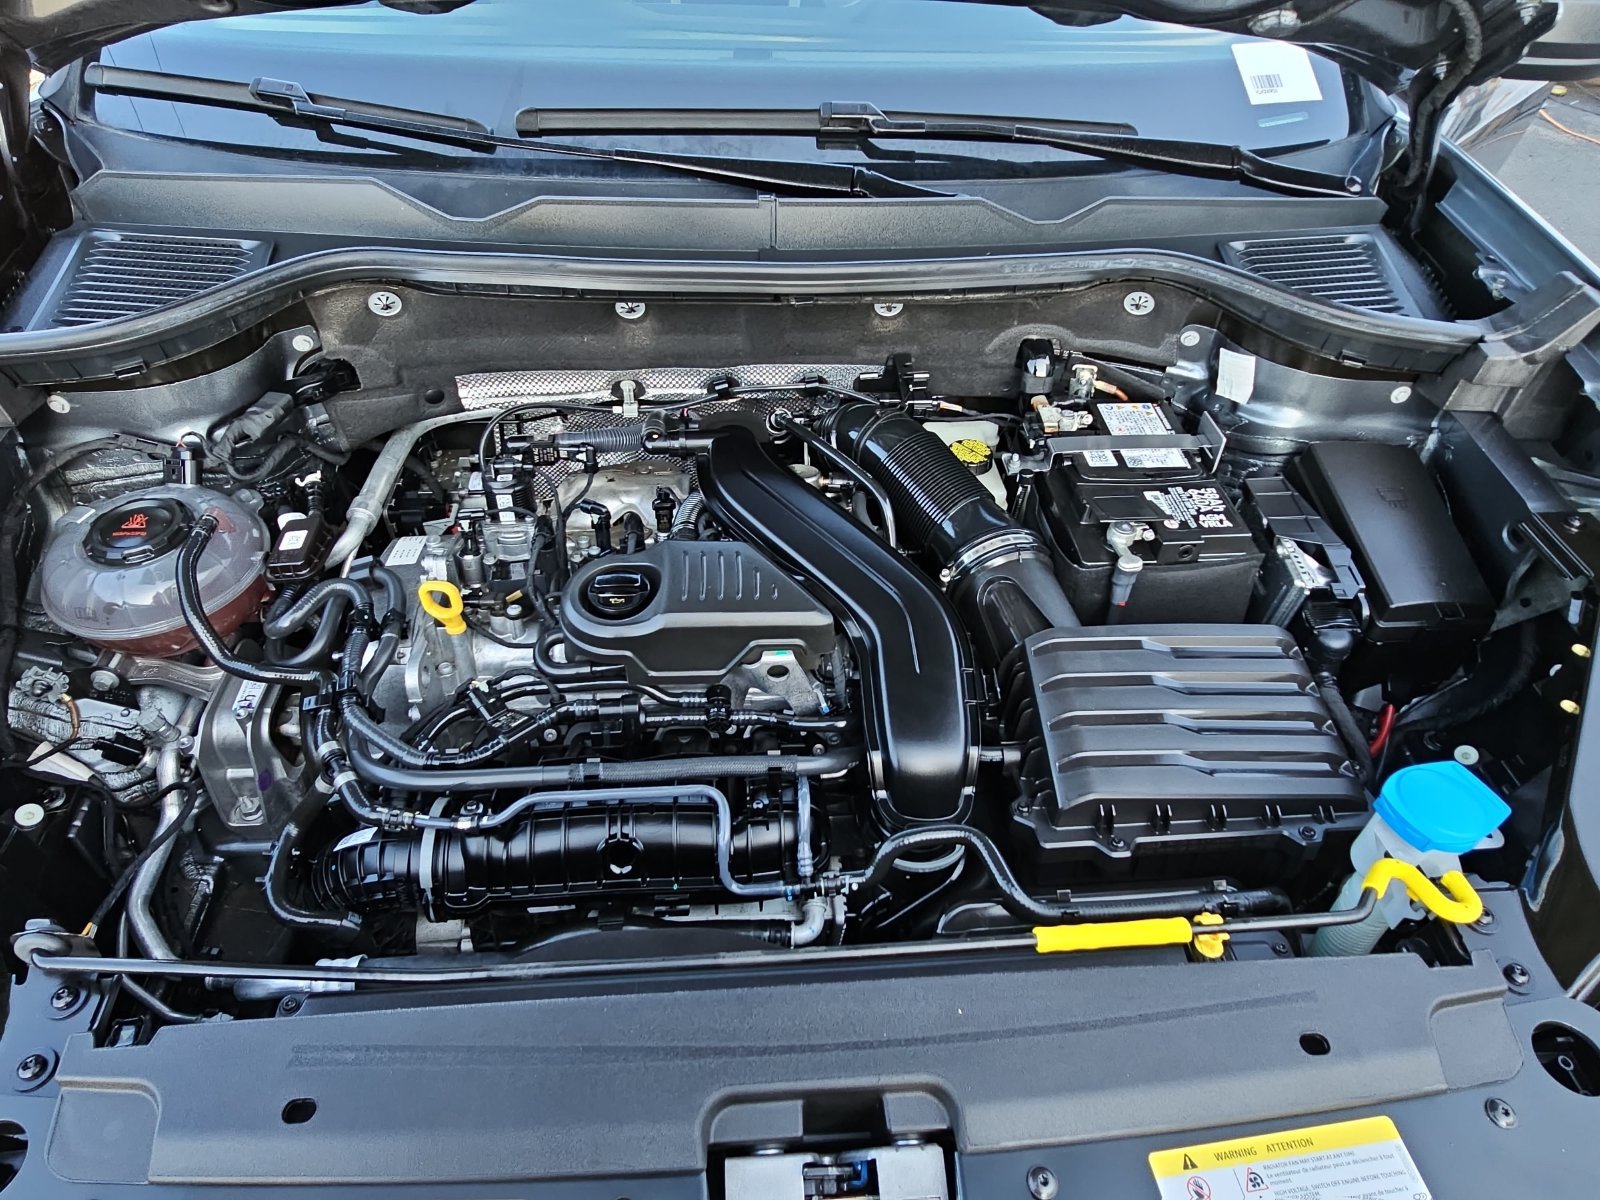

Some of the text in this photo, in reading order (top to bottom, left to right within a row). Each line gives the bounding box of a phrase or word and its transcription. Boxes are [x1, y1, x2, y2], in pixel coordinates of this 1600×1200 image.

[1198, 513, 1227, 521] AGM
[1198, 520, 1234, 528] VRLA
[1213, 1137, 1315, 1161] WARNING ATTENTION
[1263, 1162, 1288, 1170] RADIATOR
[1310, 1155, 1326, 1163] START
[1274, 1169, 1301, 1178] ventilateur
[1311, 1182, 1331, 1190] SWITCH
[1341, 1177, 1360, 1185] ENGINE
[1360, 1174, 1381, 1182] BEFORE
[1381, 1169, 1407, 1178] TOUCHING
